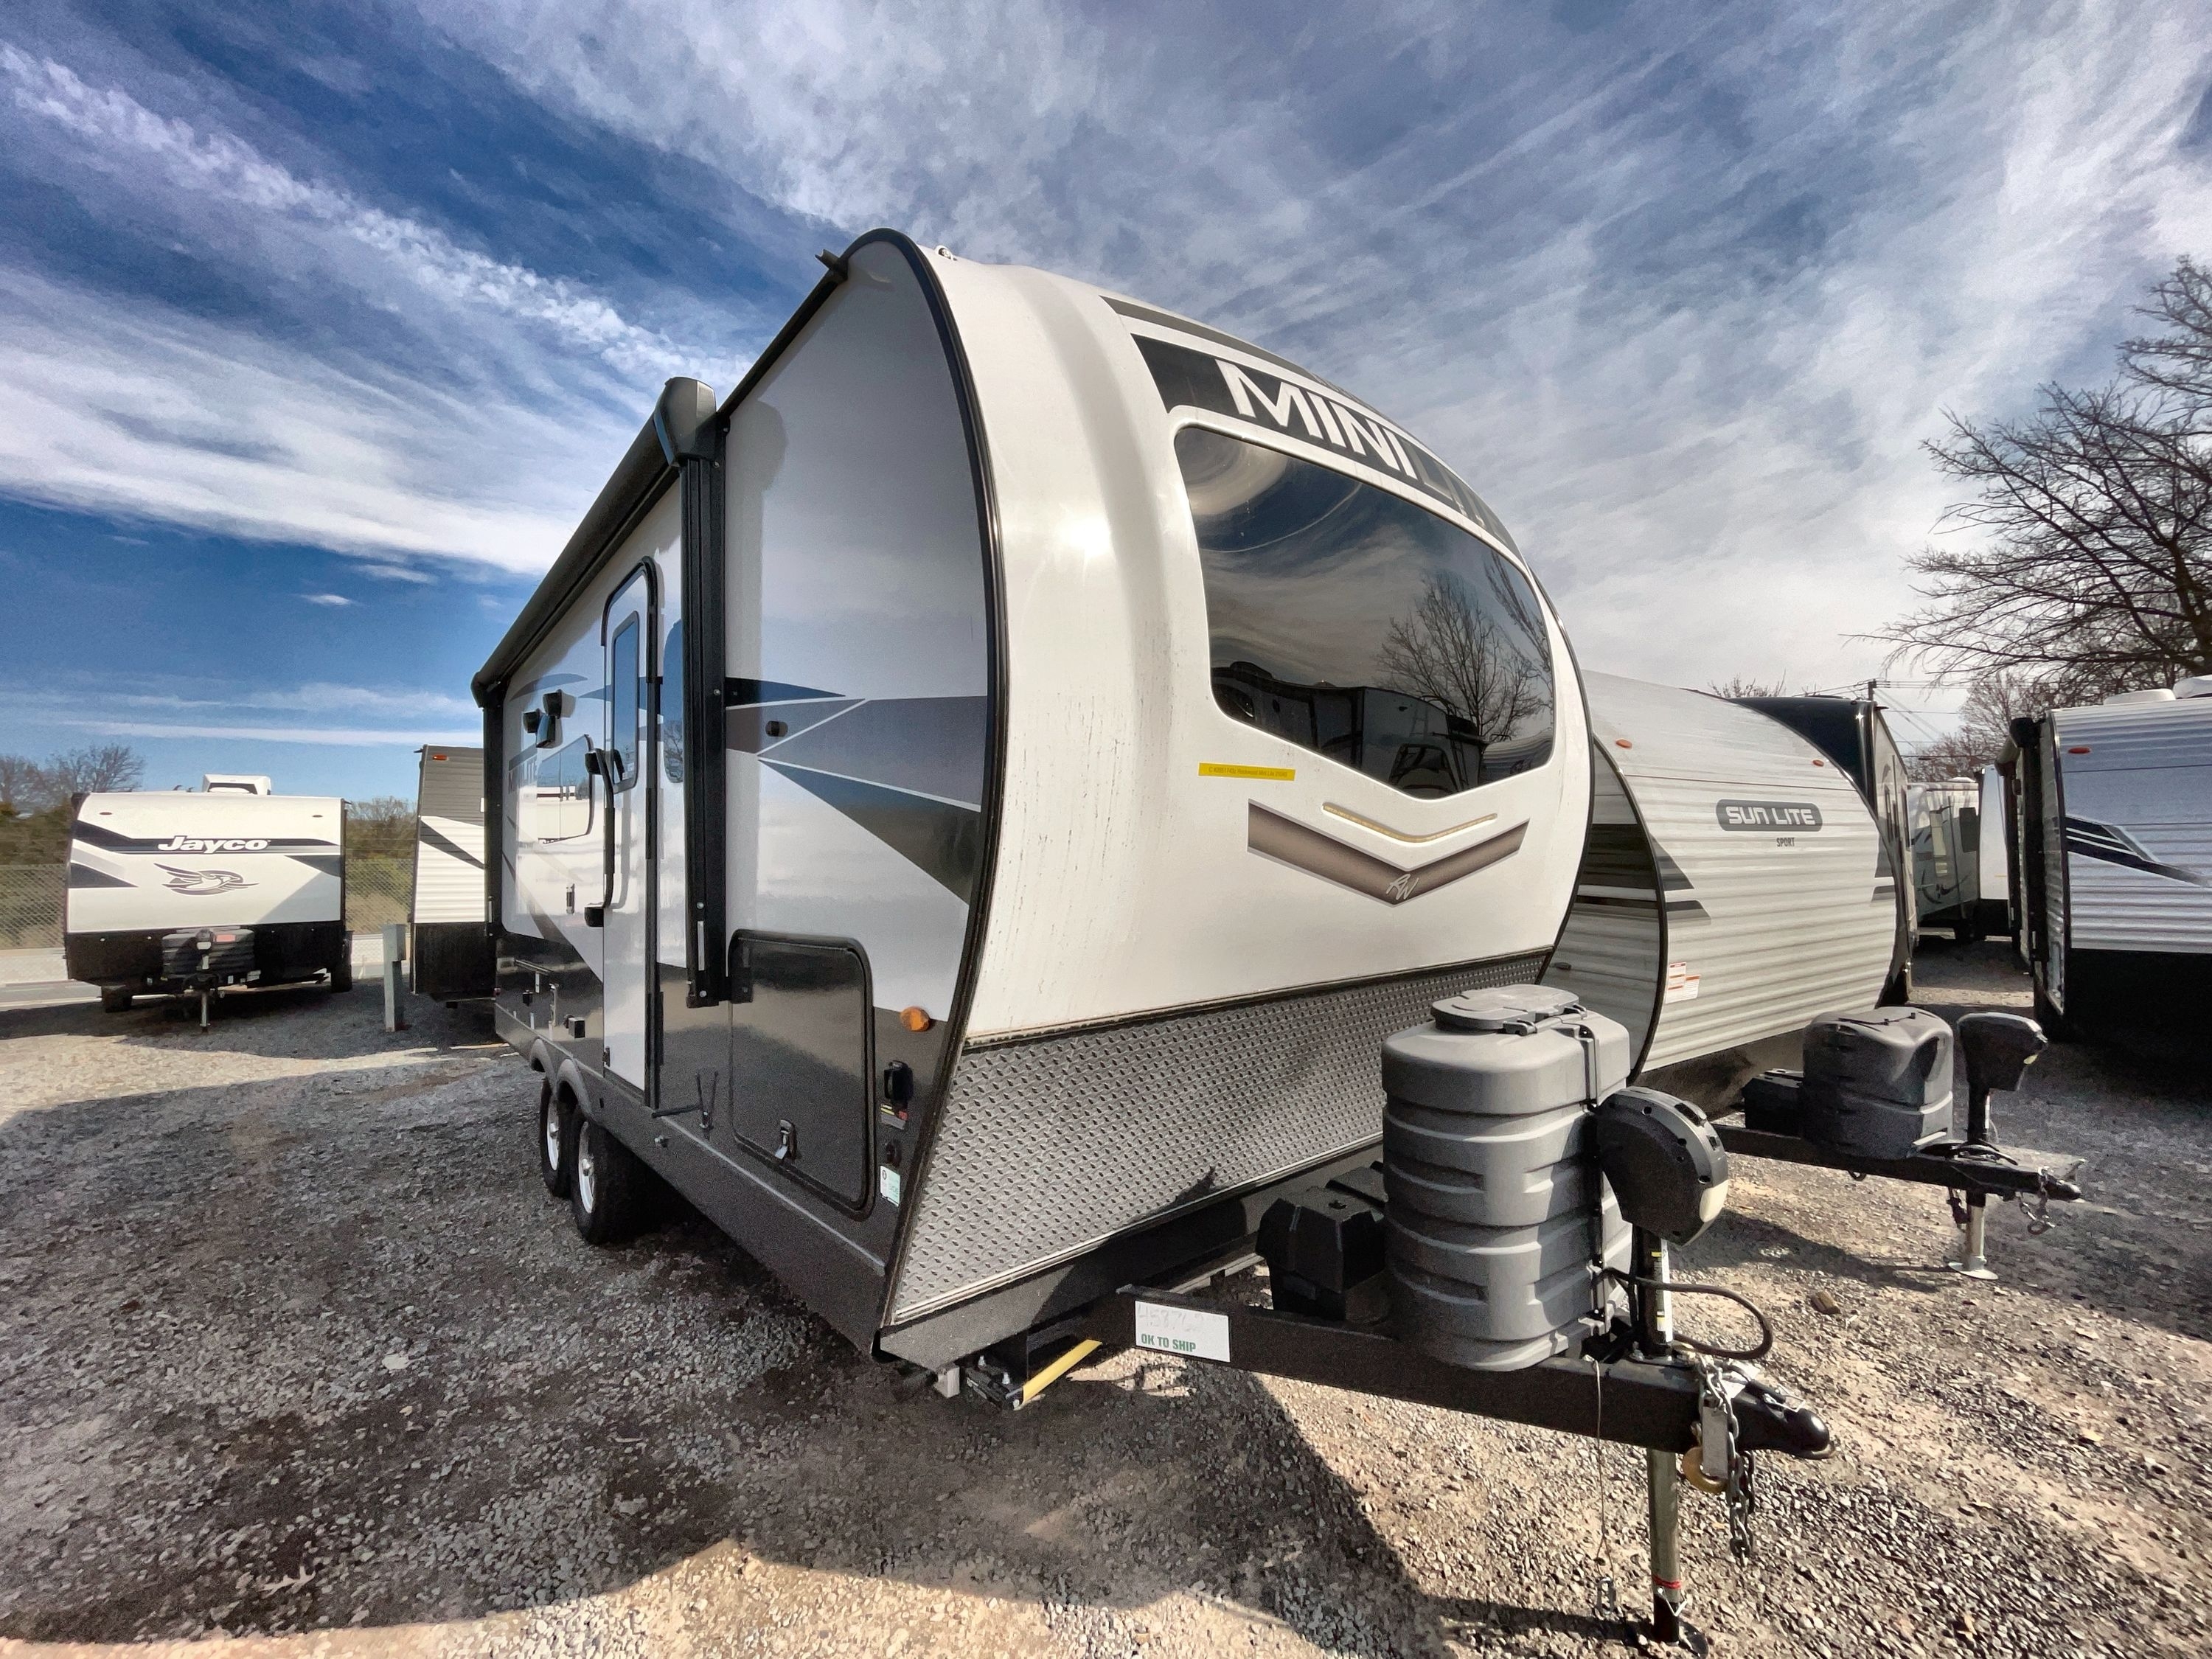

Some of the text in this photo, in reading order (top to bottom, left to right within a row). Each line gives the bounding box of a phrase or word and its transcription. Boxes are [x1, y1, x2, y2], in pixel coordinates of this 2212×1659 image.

[1215, 359, 1418, 480] MINI
[1725, 806, 1817, 825] SUN LITE
[157, 835, 268, 854] Jayco
[1776, 837, 1795, 847] SPORT
[1141, 1333, 1196, 1352] OK TO SHIP
